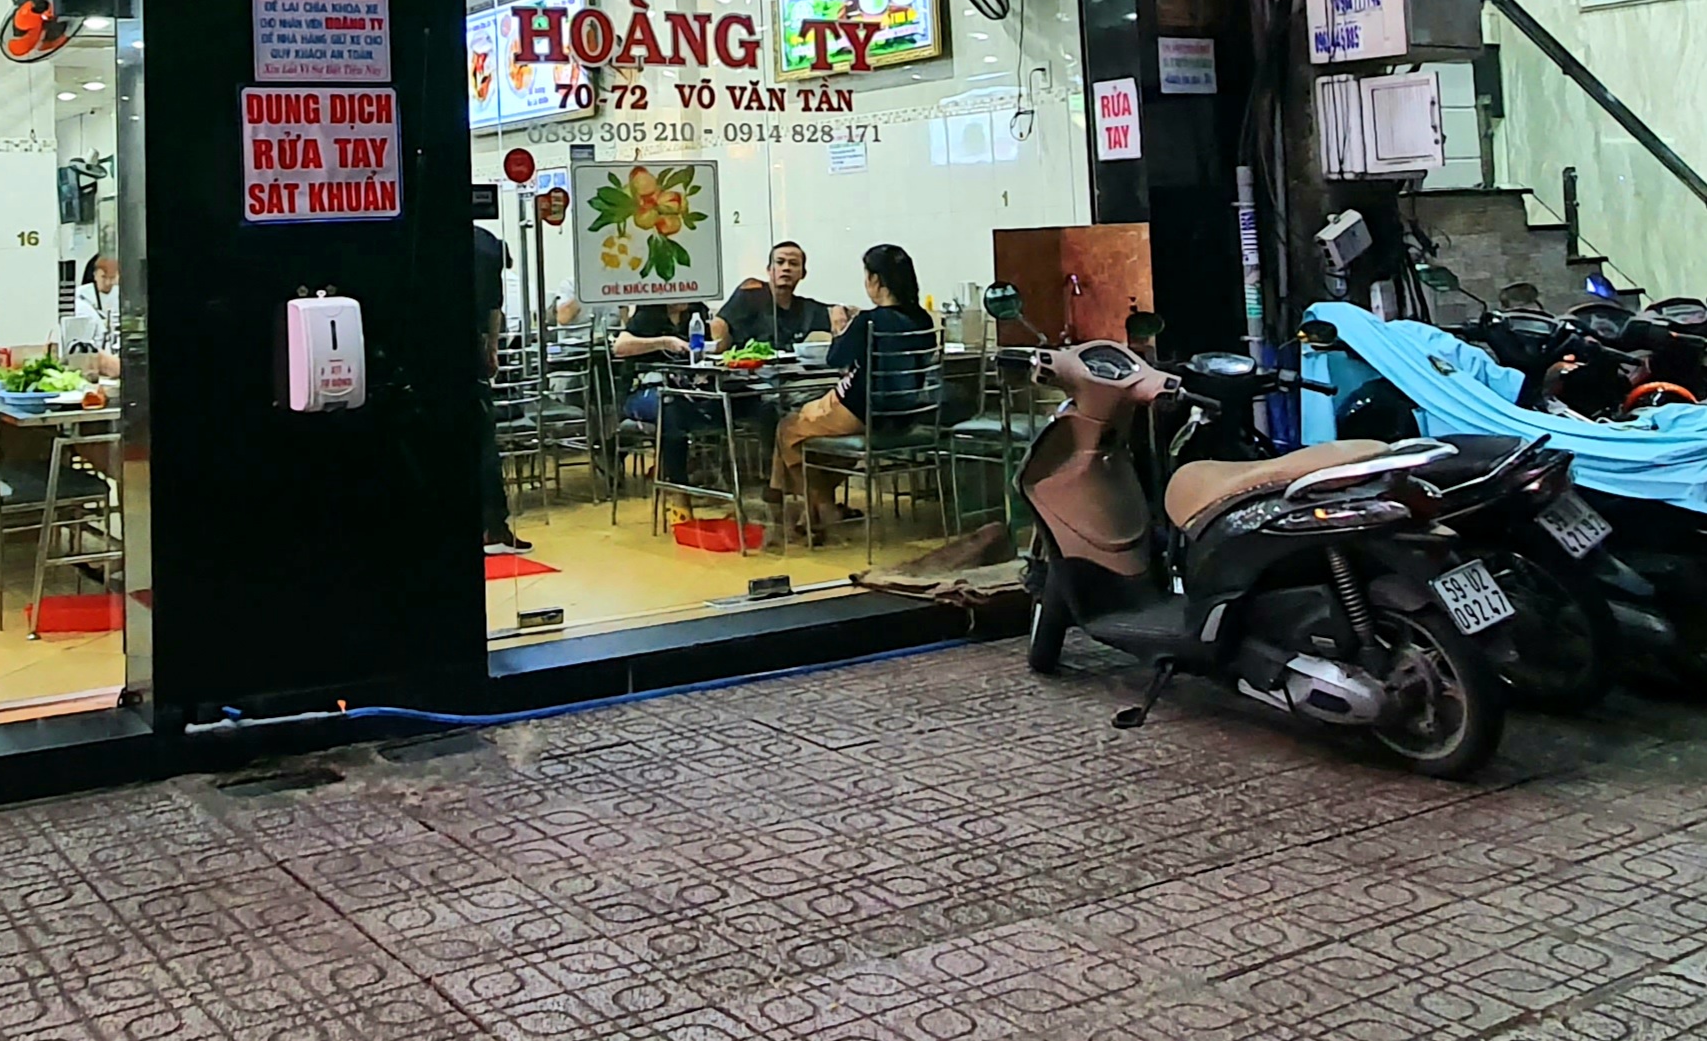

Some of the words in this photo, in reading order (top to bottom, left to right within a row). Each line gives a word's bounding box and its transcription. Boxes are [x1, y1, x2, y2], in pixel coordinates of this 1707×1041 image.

[800, 19, 882, 72] TY
[246, 93, 321, 125] DUNG
[329, 92, 393, 130] DỊCH
[674, 78, 716, 111] VÕ
[725, 82, 787, 112] VĂN
[796, 77, 854, 113] TẦN
[252, 131, 323, 170] RỬA
[334, 138, 388, 169] TAY
[528, 123, 593, 145] 0839
[599, 123, 647, 144] 305
[654, 121, 694, 143] 210
[723, 123, 782, 143] 0914
[792, 123, 835, 144] 828
[846, 123, 882, 144] 171
[1105, 124, 1130, 150] TAY
[248, 177, 300, 216] SÁT
[308, 170, 397, 213] KHUẨN
[732, 211, 741, 224] 2
[17, 231, 40, 247] 16
